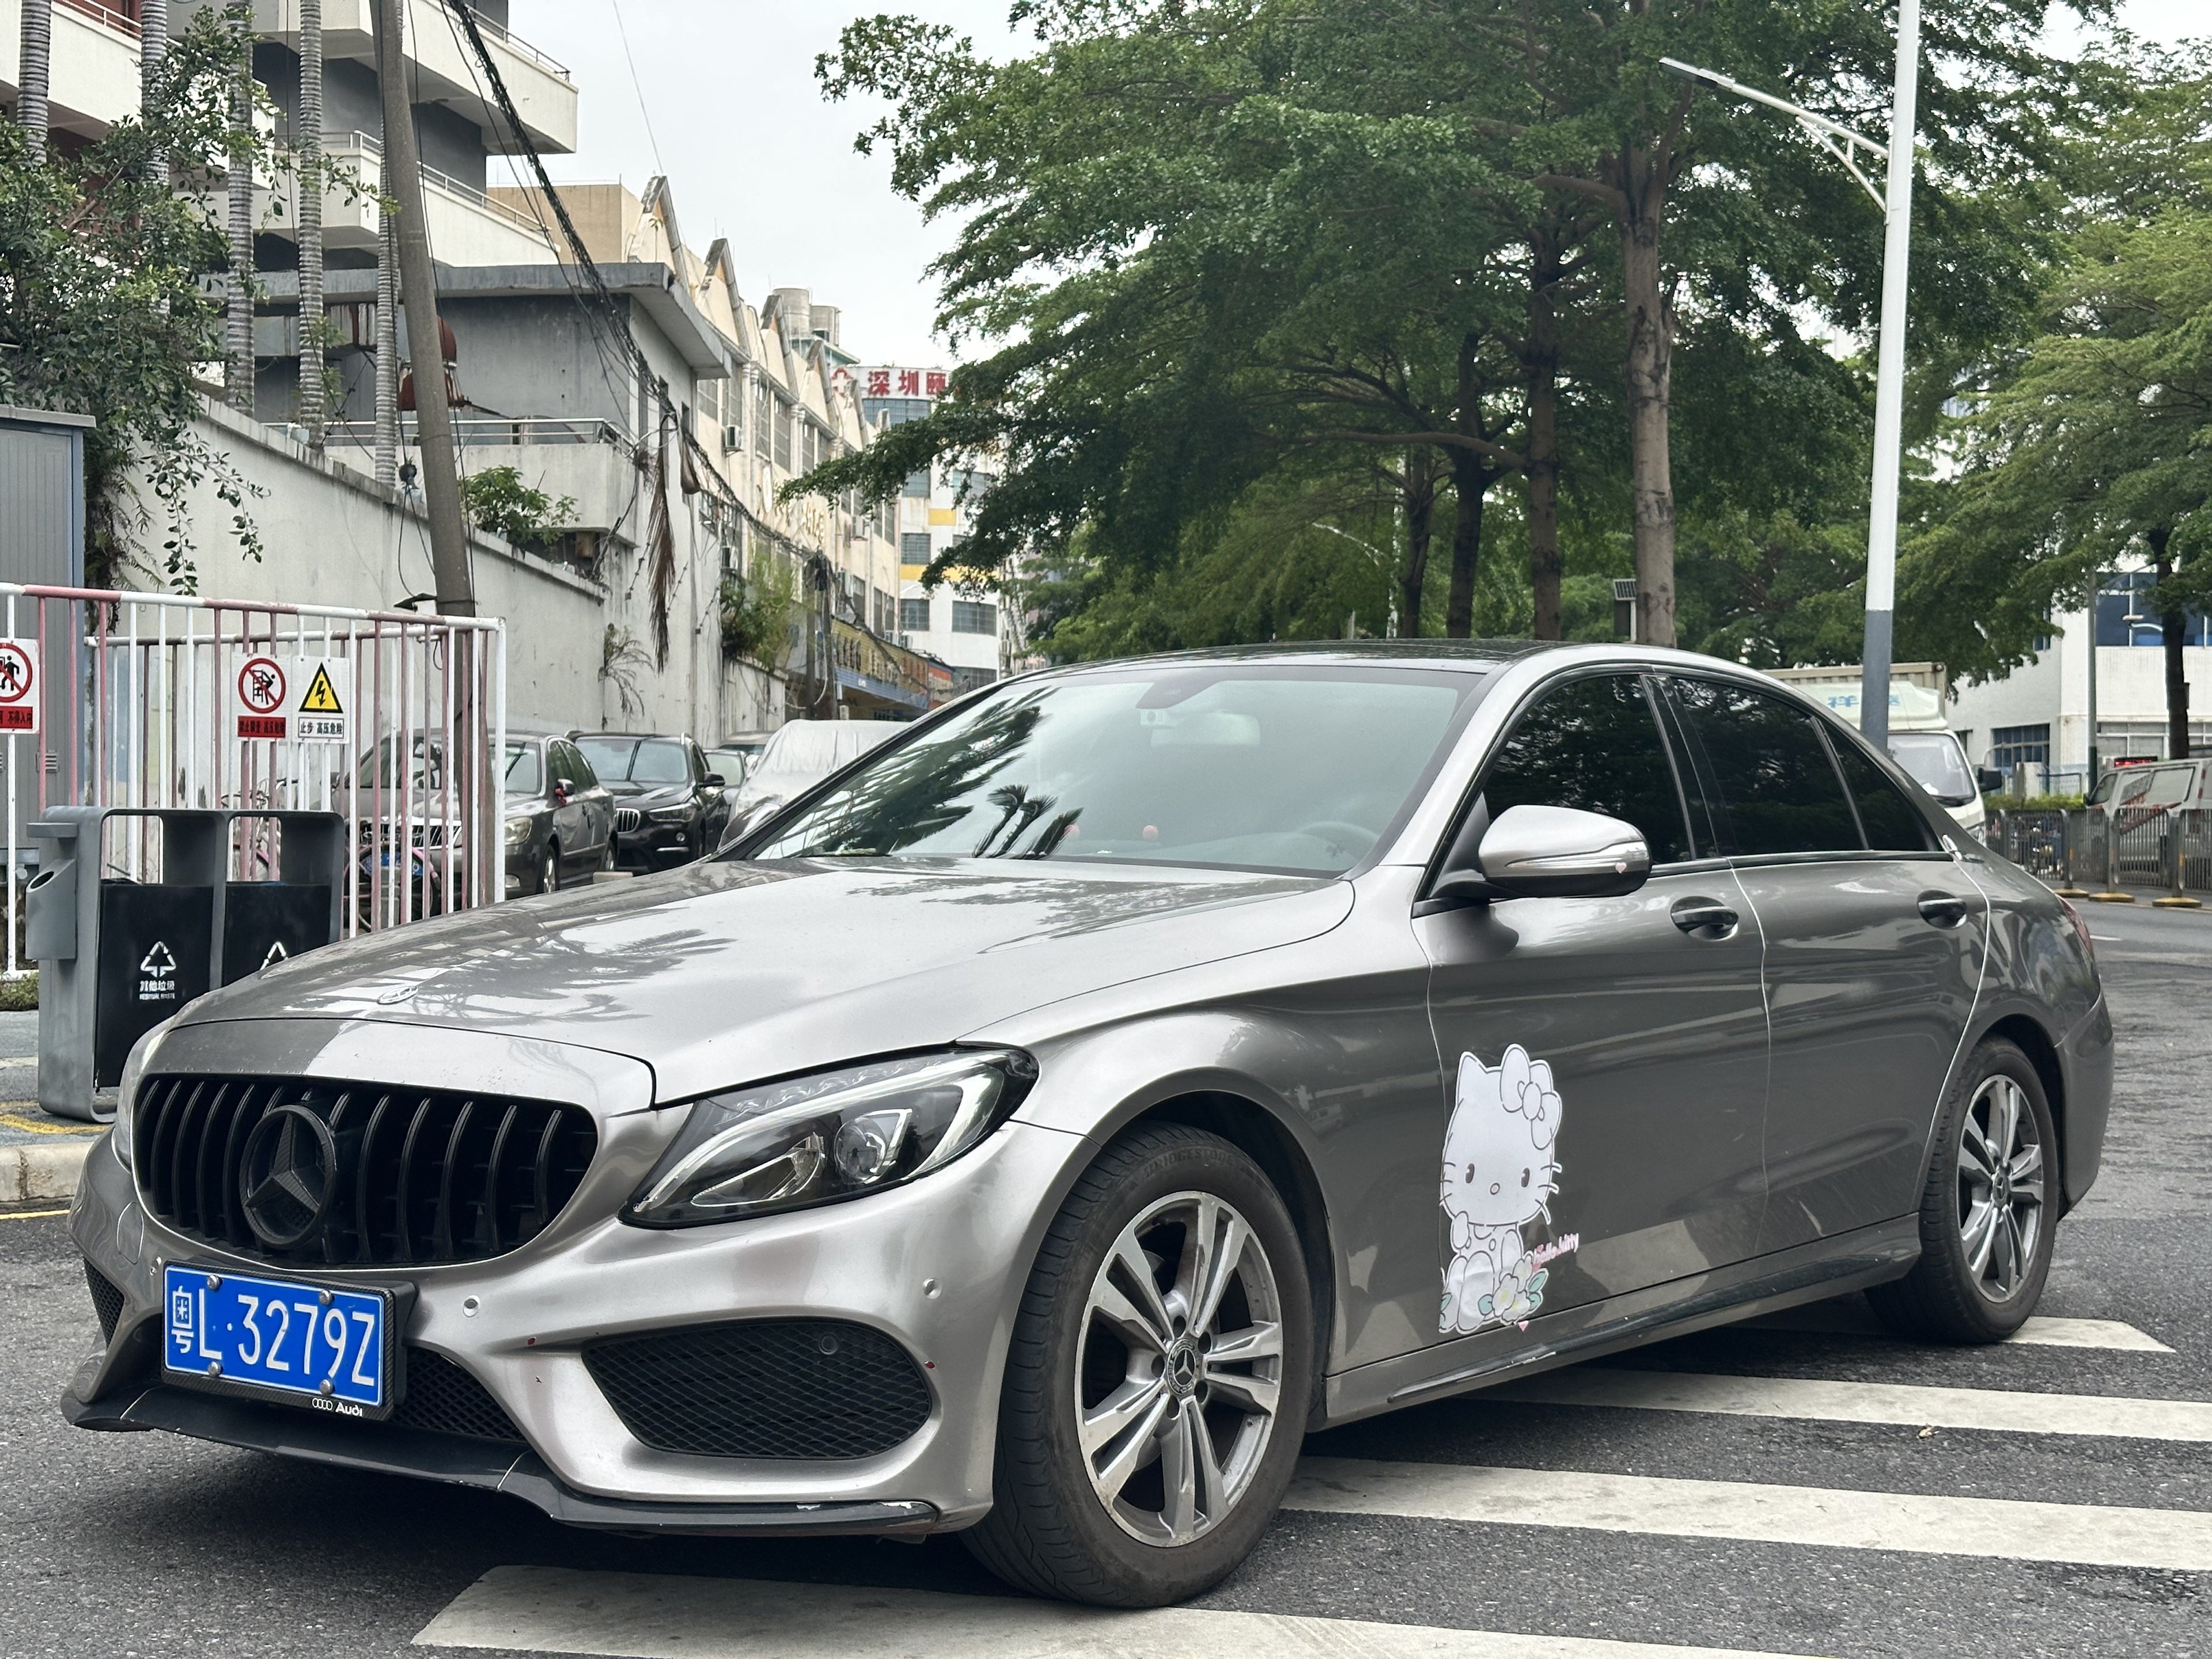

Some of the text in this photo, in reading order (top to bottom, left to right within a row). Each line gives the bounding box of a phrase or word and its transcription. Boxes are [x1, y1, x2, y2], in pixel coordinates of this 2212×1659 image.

[300, 721, 343, 734] 止步 高压危险
[139, 980, 175, 992] 其他垃圾
[335, 1402, 363, 1417] Audi
